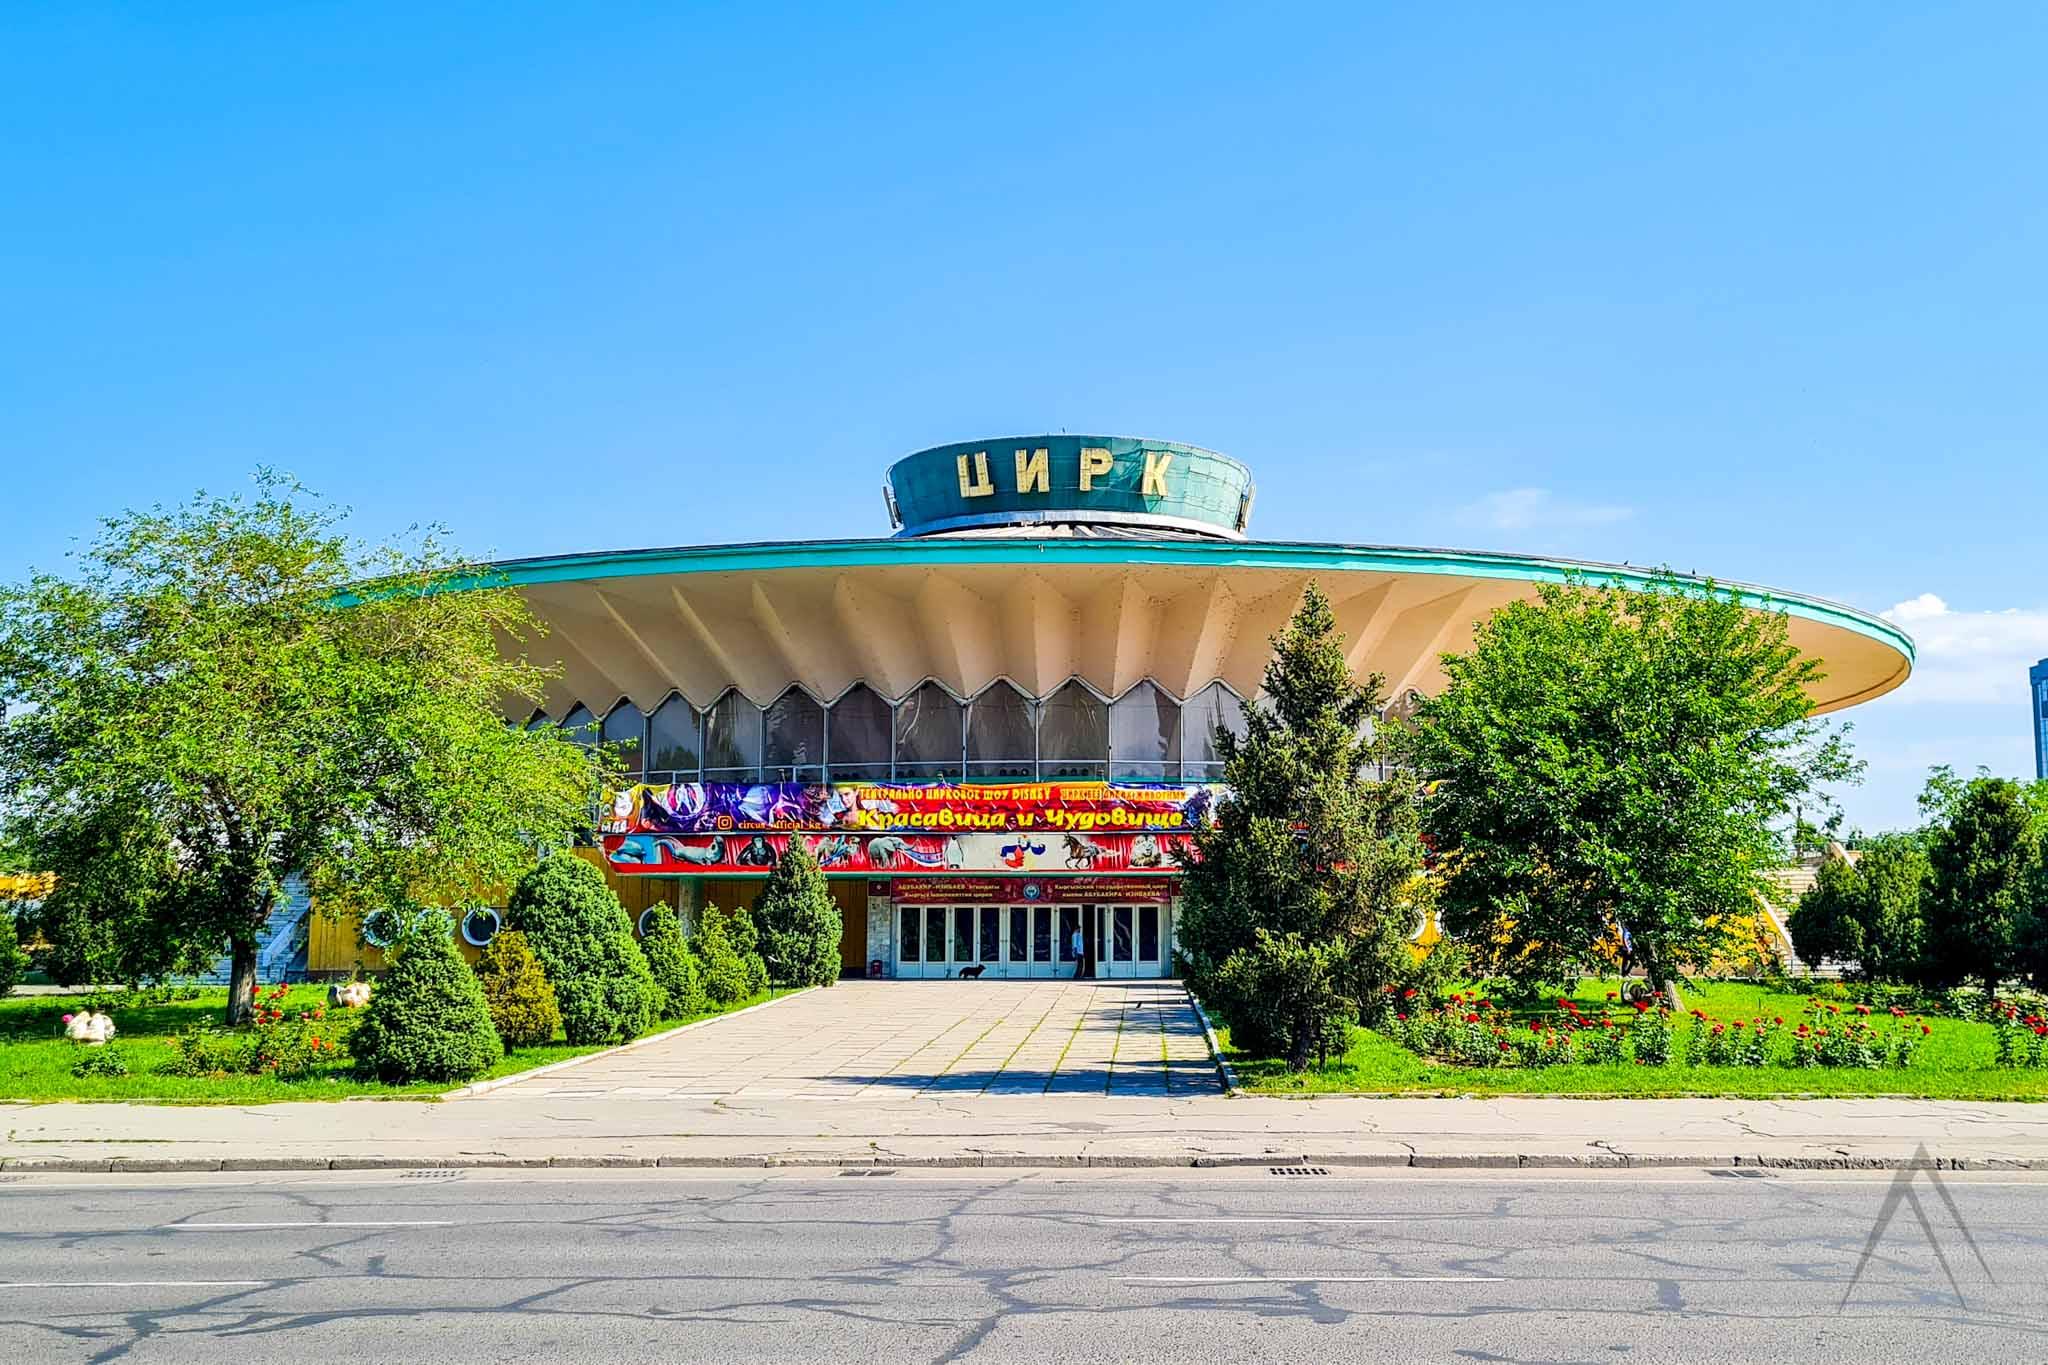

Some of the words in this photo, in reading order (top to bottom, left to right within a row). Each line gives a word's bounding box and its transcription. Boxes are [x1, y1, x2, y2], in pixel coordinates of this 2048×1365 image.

[956, 447, 1173, 498] ЦИРК
[925, 787, 981, 801] ЦИРКОВОЕ
[983, 788, 1008, 801] ШОУ
[1011, 787, 1050, 801] DISNEY
[856, 807, 1007, 830] Красавица
[1015, 812, 1035, 827] и
[1044, 806, 1184, 831] Чудовище
